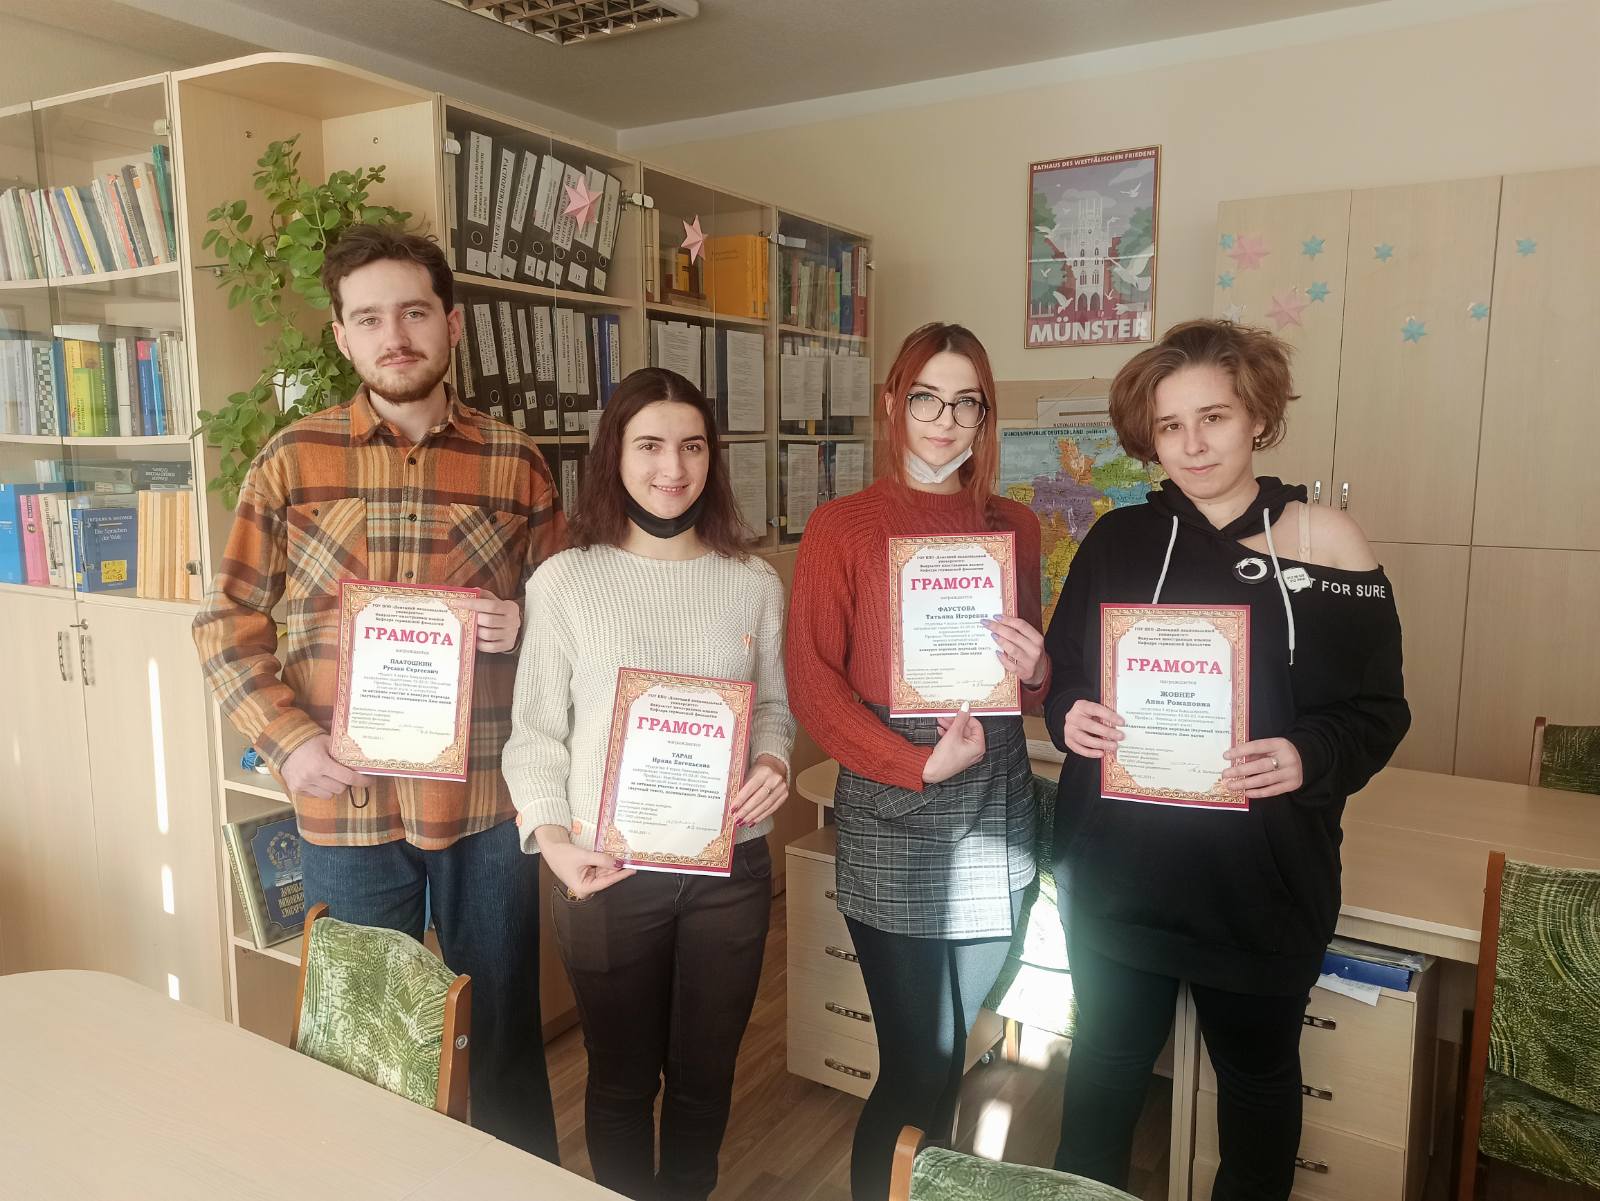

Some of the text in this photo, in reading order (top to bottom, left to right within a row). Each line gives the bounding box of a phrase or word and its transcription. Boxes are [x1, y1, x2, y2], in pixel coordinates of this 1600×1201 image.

[1074, 154, 1123, 165] WESTFÄLISCHEN
[1125, 150, 1155, 159] FRIEDENS
[1029, 316, 1151, 342] MÜNSTER
[911, 576, 994, 591] ГРАМОТА
[1322, 581, 1351, 595] FOR
[1356, 584, 1385, 598] SURE
[364, 627, 453, 646] ГРАМОТА
[391, 659, 432, 667] ПЛАТОШКИН
[1127, 658, 1223, 674] ГРАМОТА
[637, 716, 726, 738] ГРАМОТА
